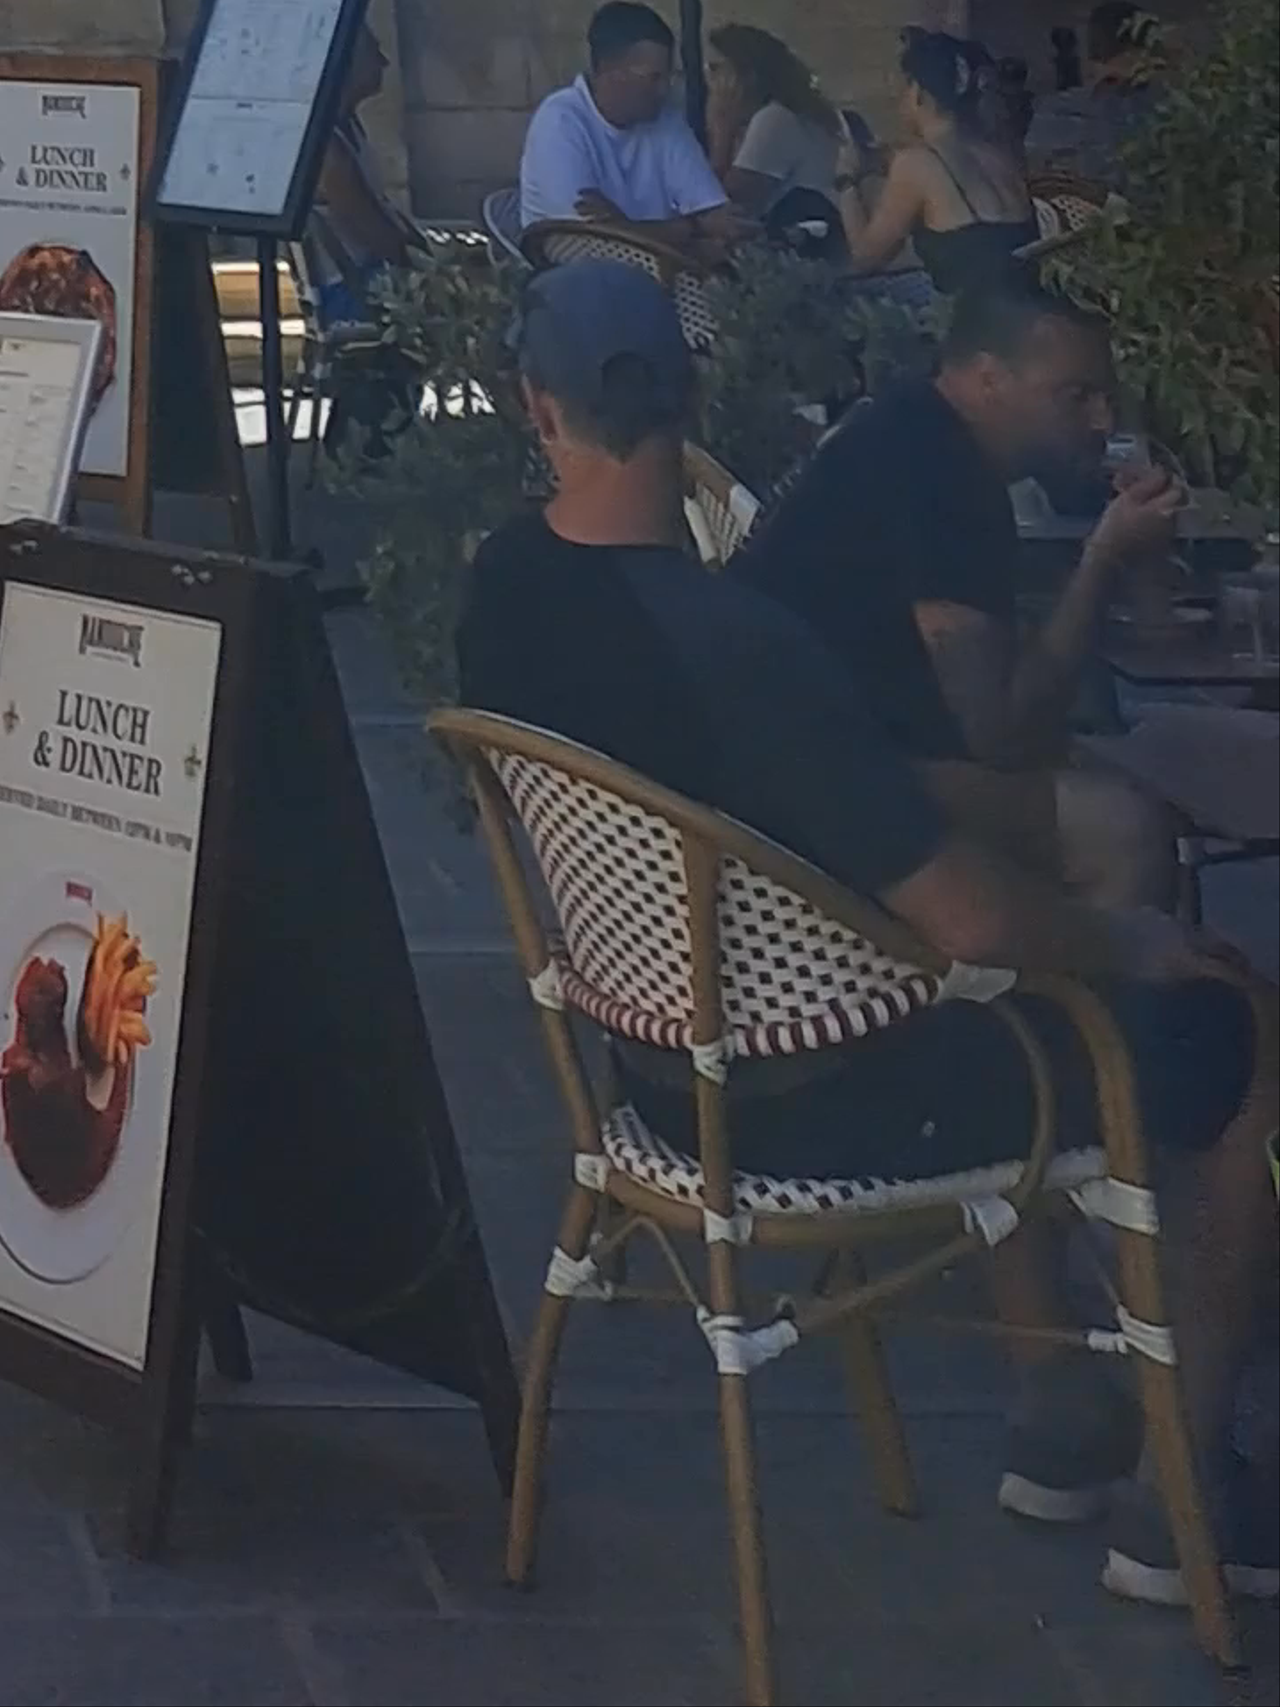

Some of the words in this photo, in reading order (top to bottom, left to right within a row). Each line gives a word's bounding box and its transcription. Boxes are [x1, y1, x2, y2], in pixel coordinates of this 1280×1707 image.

[30, 145, 95, 168] LUNCH
[15, 166, 29, 187] &
[34, 168, 108, 192] DINNER
[56, 689, 150, 746] LUNCH
[33, 730, 53, 768] &
[59, 735, 162, 796] DINNER
